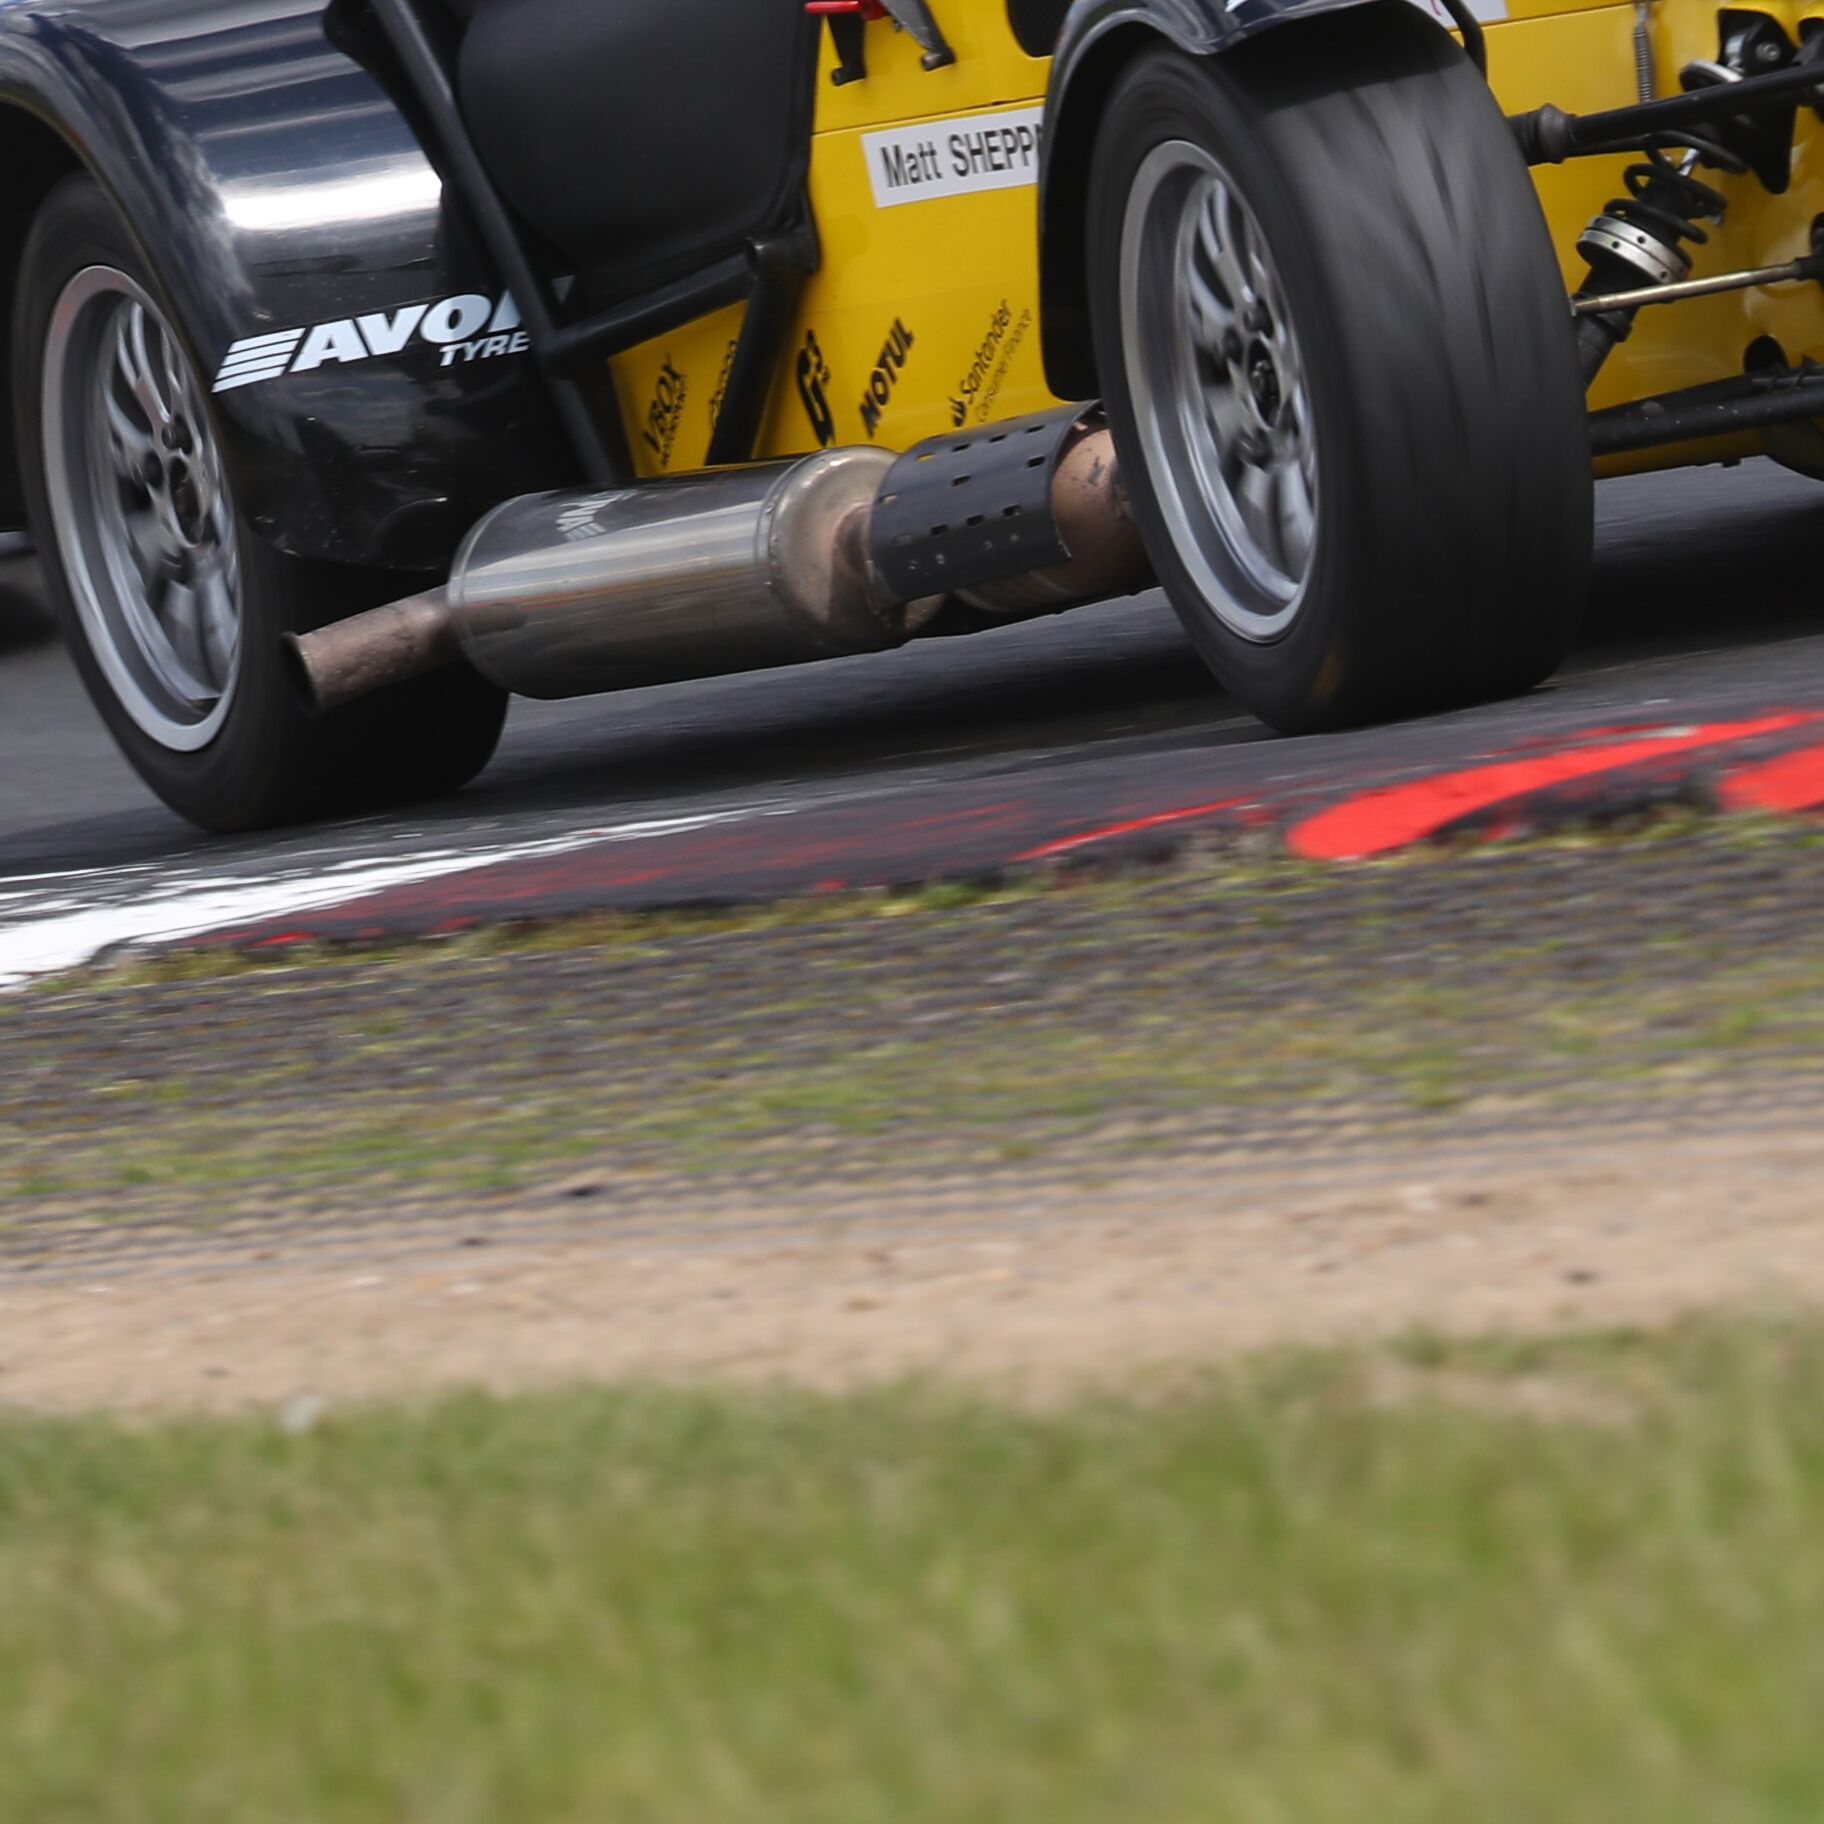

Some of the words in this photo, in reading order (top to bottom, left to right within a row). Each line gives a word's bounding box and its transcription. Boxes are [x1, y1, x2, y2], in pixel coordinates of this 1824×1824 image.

[880, 140, 943, 188] Matt
[439, 330, 531, 367] TYRE
[859, 317, 914, 439] MOTUL
[960, 298, 1012, 405] Santander
